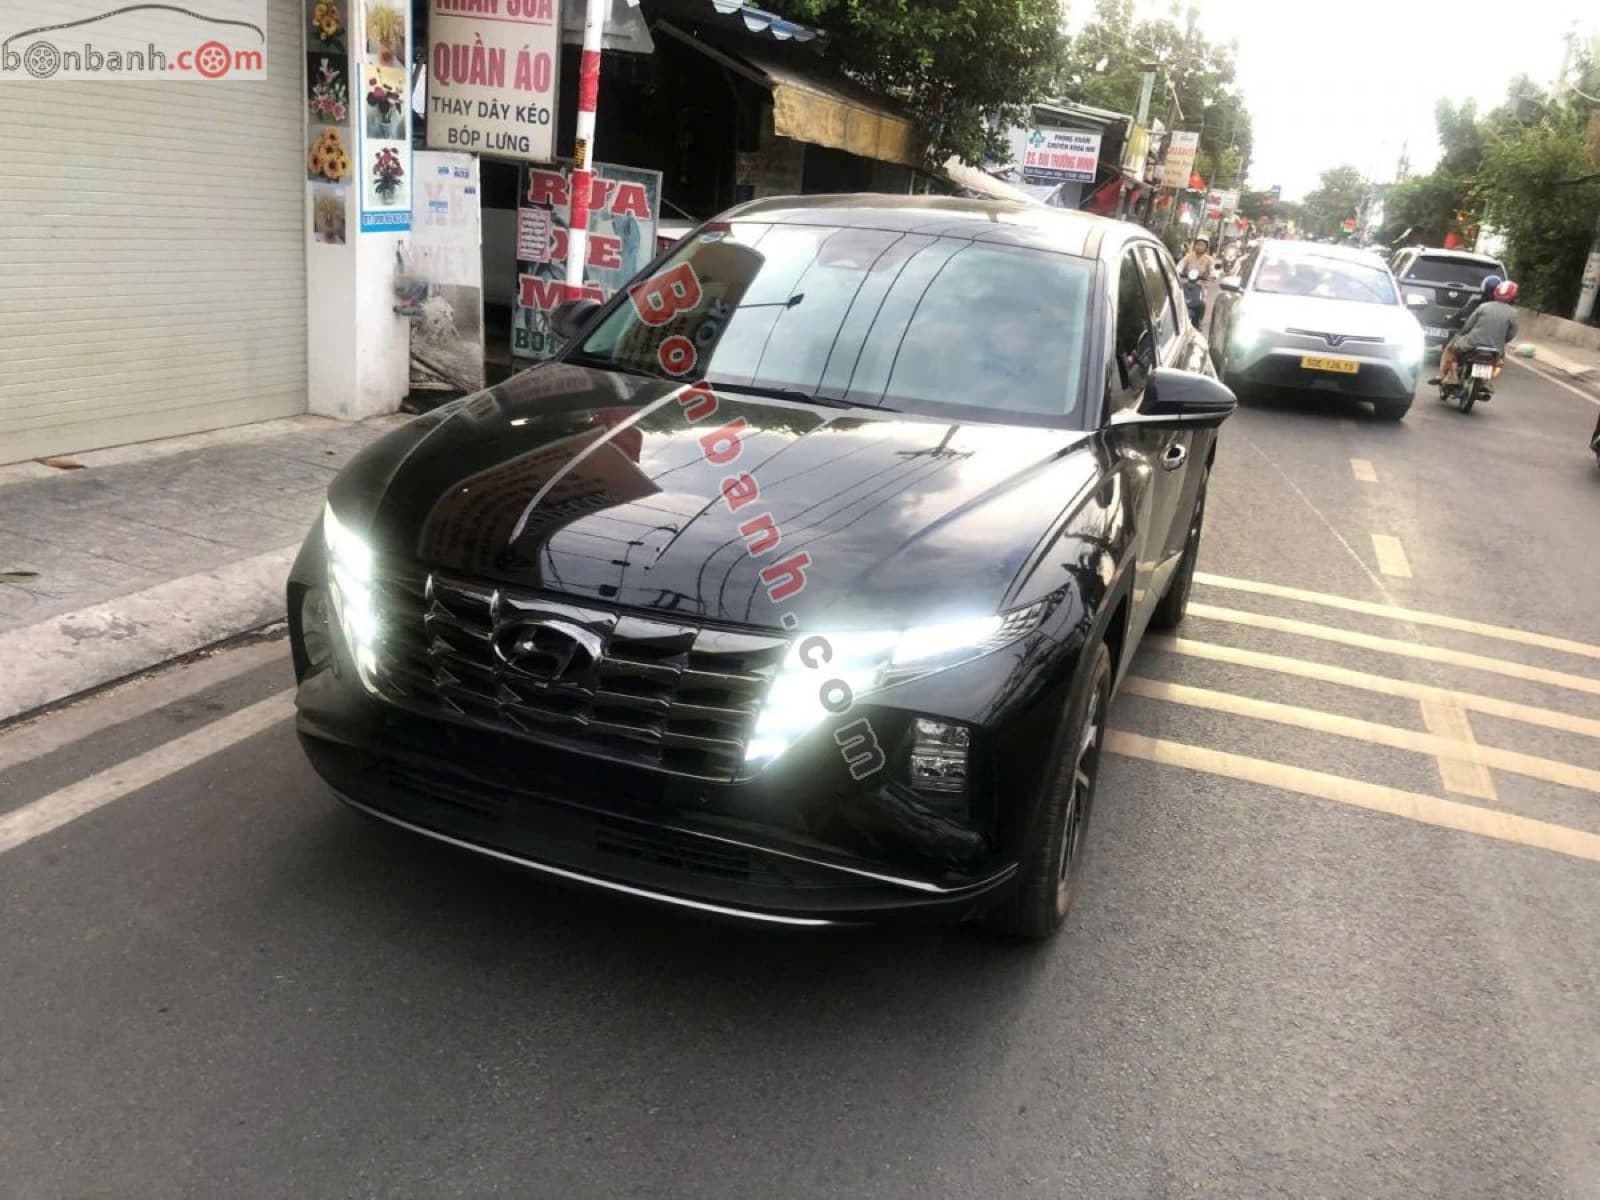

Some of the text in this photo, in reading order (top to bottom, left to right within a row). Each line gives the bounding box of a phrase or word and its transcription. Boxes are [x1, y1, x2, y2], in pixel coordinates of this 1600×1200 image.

[432, 32, 552, 94] QUẦN ÁO
[431, 96, 550, 126] THAY DÂY KÉO
[447, 124, 531, 154] BÓP LƯNG
